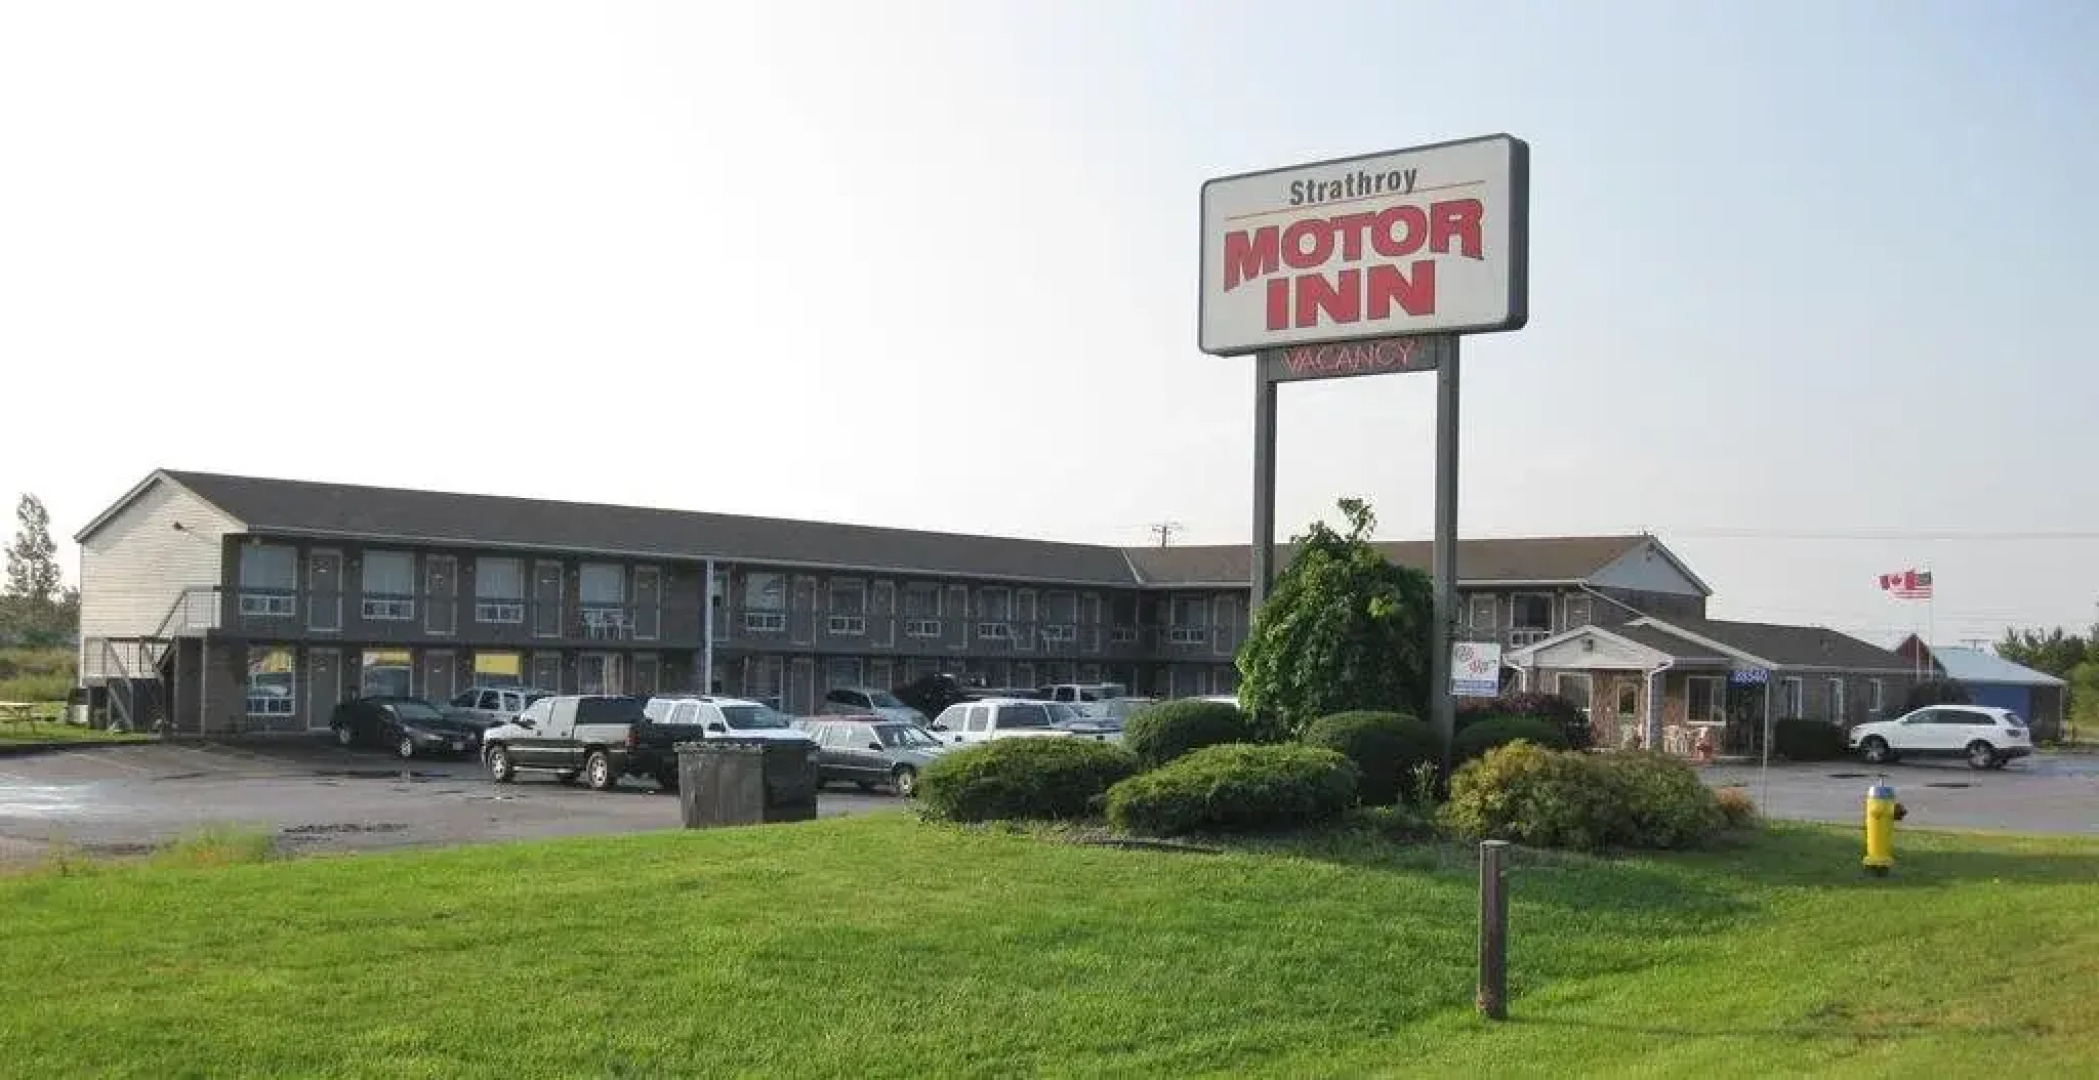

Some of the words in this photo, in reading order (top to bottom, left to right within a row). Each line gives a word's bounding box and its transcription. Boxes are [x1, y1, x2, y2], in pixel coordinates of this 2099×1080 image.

[1290, 168, 1417, 206] Strathroy
[1224, 198, 1484, 293] MOTOR
[1266, 260, 1436, 330] INN
[1282, 337, 1416, 373] VACANCY
